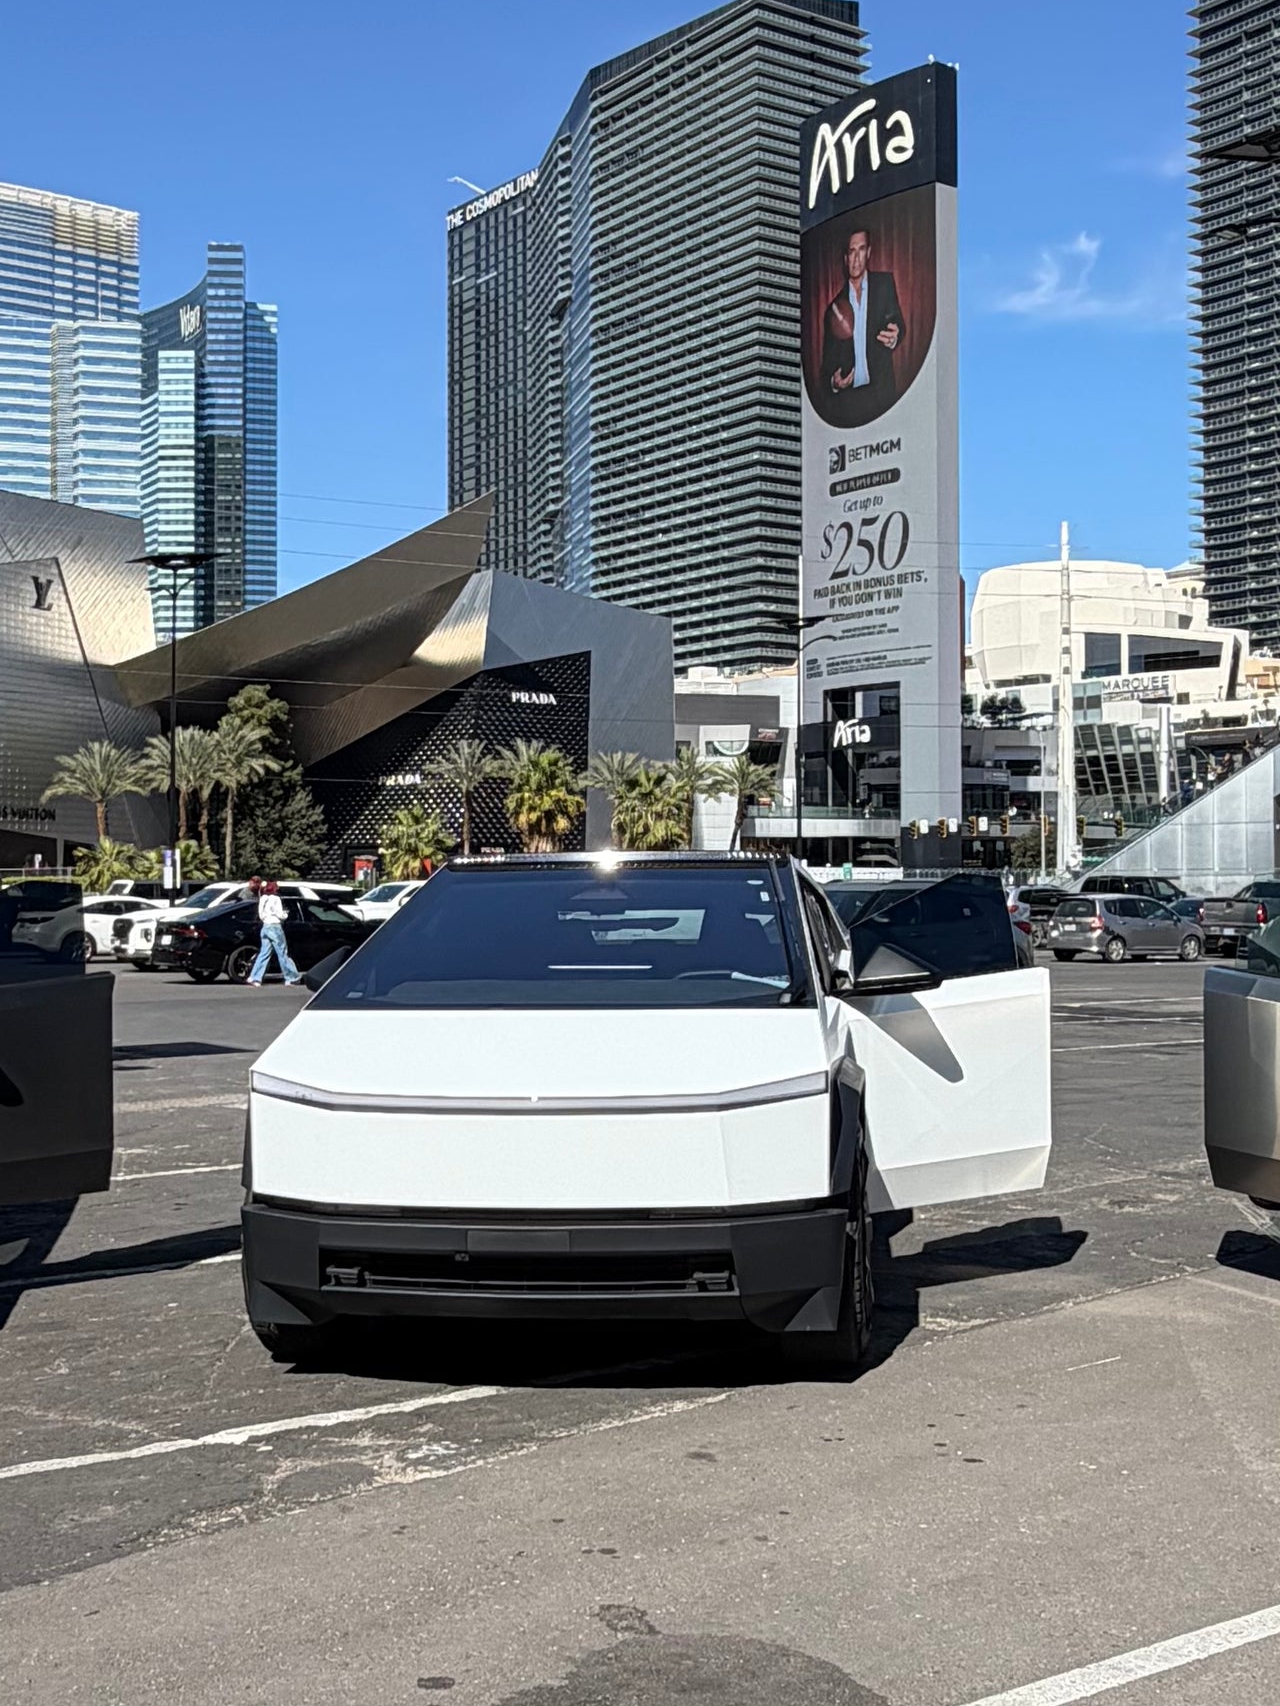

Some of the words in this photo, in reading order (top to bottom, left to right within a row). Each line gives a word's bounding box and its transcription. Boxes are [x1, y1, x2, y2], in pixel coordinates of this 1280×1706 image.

[808, 99, 914, 209] Aria
[848, 437, 901, 463] BETMGM
[843, 499, 858, 512] Get
[859, 497, 871, 511] up
[873, 496, 883, 506] to
[821, 511, 909, 581] $250
[813, 587, 829, 599] PAID
[831, 583, 851, 598] BACK
[853, 581, 862, 592] IN
[864, 575, 895, 589] BONUS
[829, 598, 836, 609] IF
[838, 595, 853, 608] YOU
[855, 590, 881, 604] DON'T
[884, 587, 903, 600] WIN
[1102, 675, 1169, 690] MARQUEE
[512, 692, 557, 705] PRADA
[833, 718, 871, 748] Aria
[378, 773, 421, 786] PRADA
[11, 807, 56, 821] VUITTON
